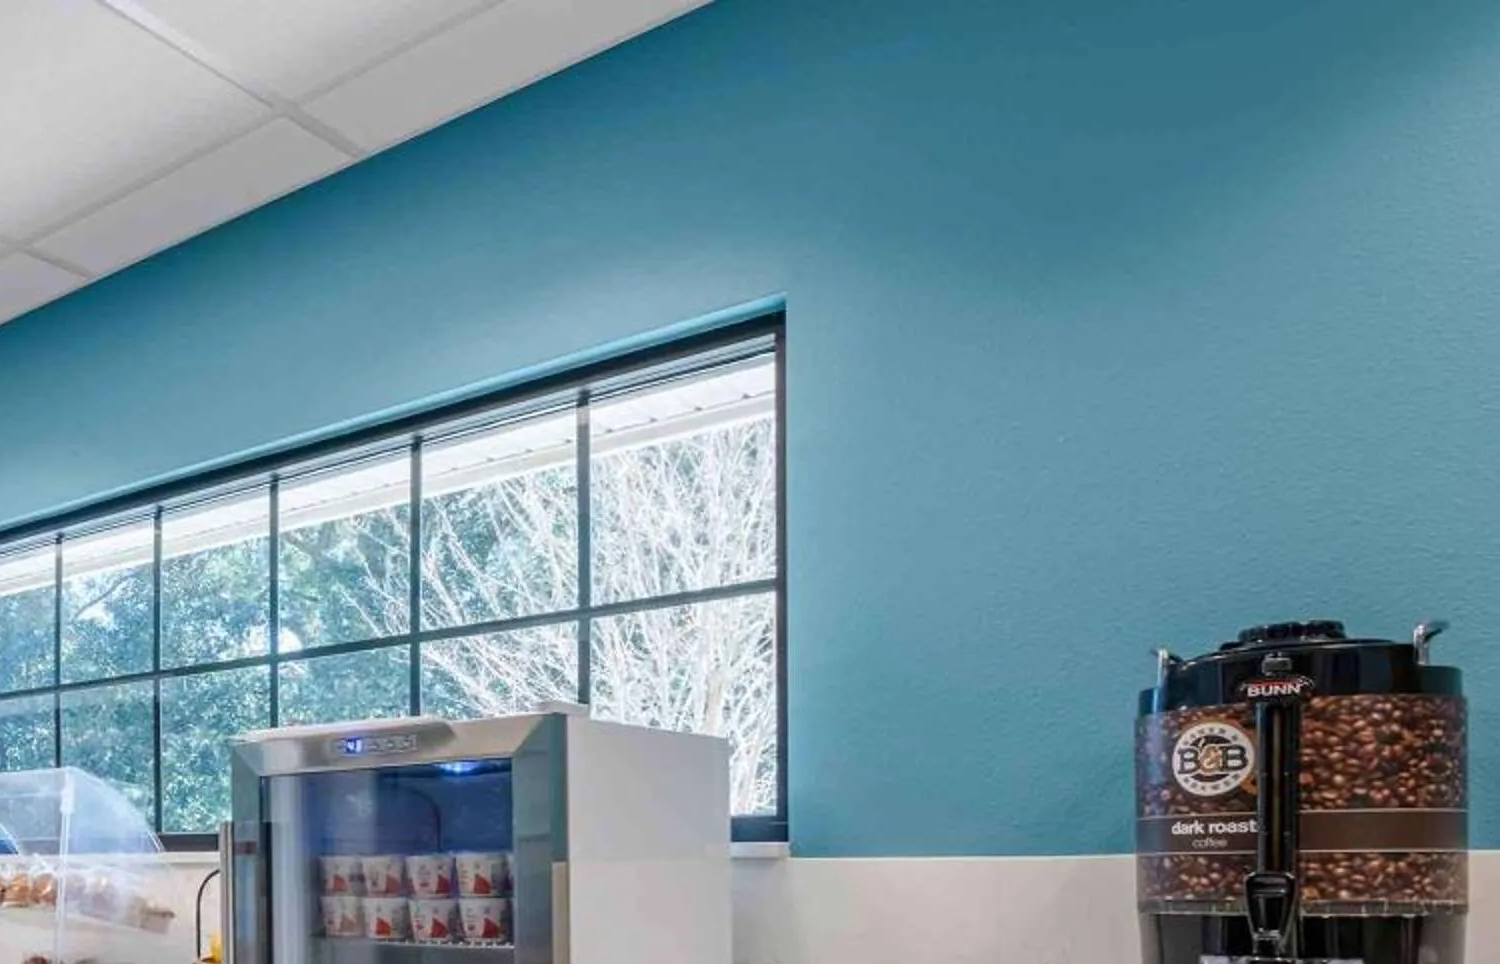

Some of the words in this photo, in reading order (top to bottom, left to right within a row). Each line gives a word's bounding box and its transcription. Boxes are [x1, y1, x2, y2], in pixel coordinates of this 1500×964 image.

[1247, 682, 1301, 697] BUNN
[1171, 820, 1205, 835] dark
[1208, 819, 1258, 834] roast
